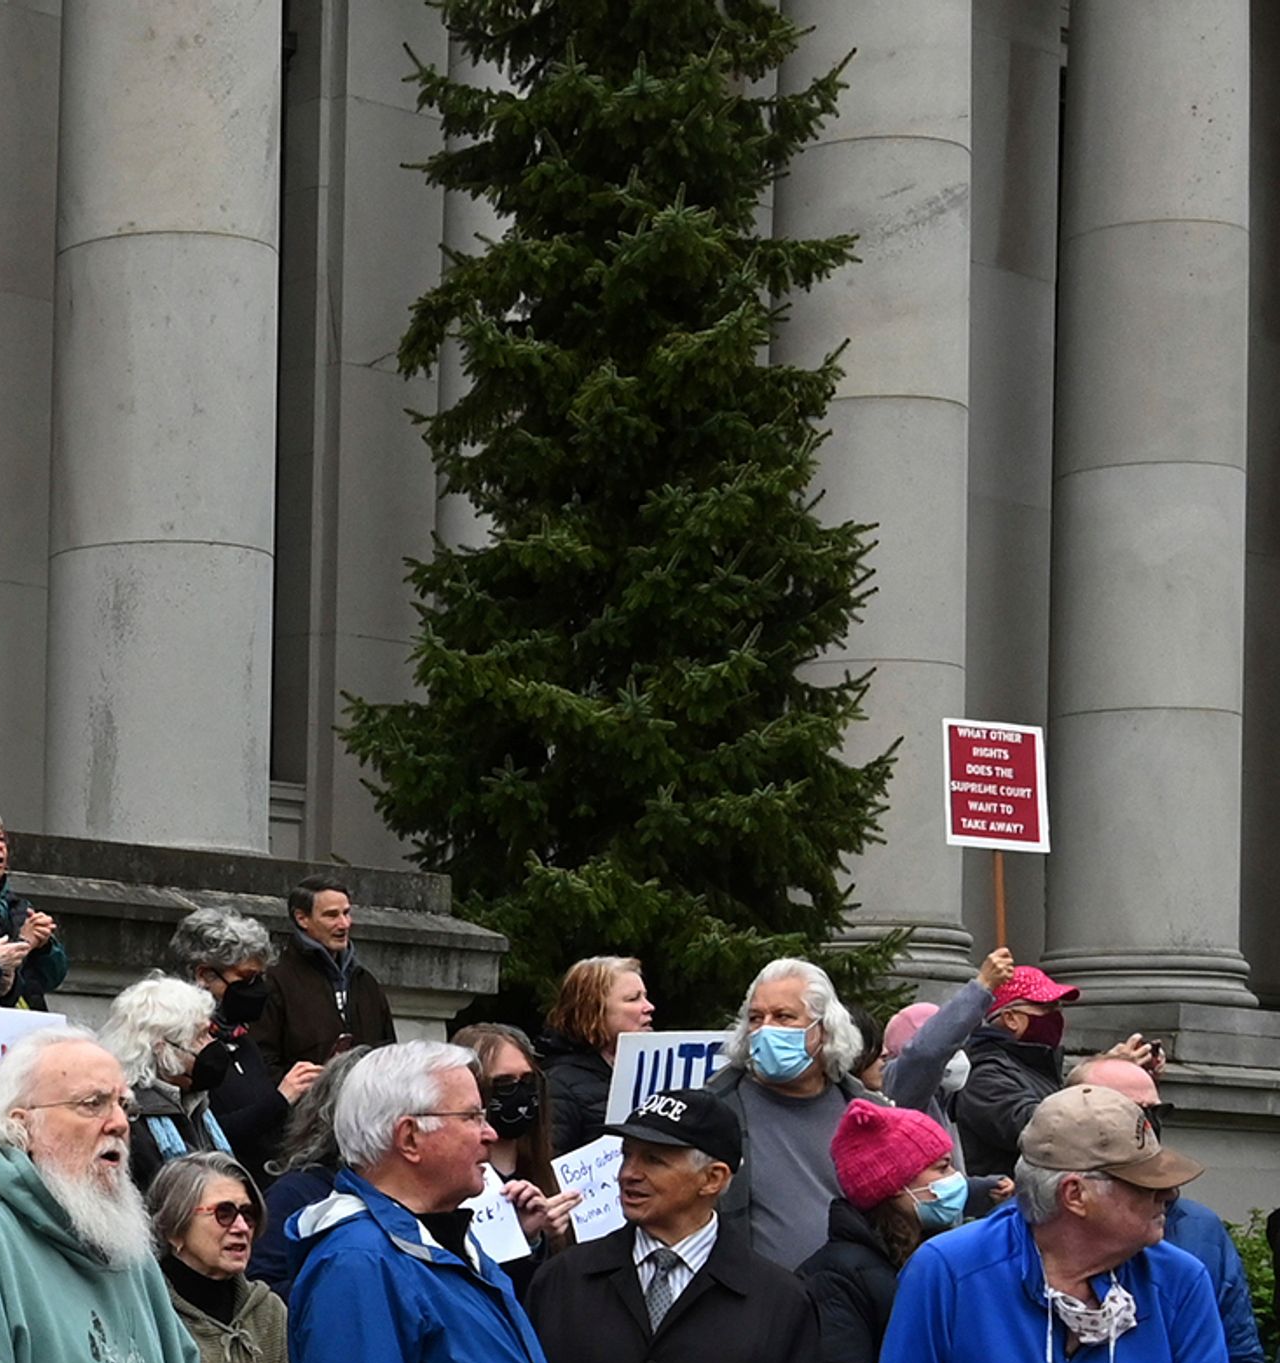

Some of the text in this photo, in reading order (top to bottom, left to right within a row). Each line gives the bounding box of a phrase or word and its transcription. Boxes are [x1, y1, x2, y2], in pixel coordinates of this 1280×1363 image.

[957, 727, 1023, 744] WHAT OTHER
[972, 746, 1010, 760] RIGHTS
[966, 763, 1014, 779] DOES THE
[950, 780, 1033, 799] SUPREME COURT
[967, 800, 1014, 815] WANT TO
[961, 817, 1024, 834] TAKE AWAY?
